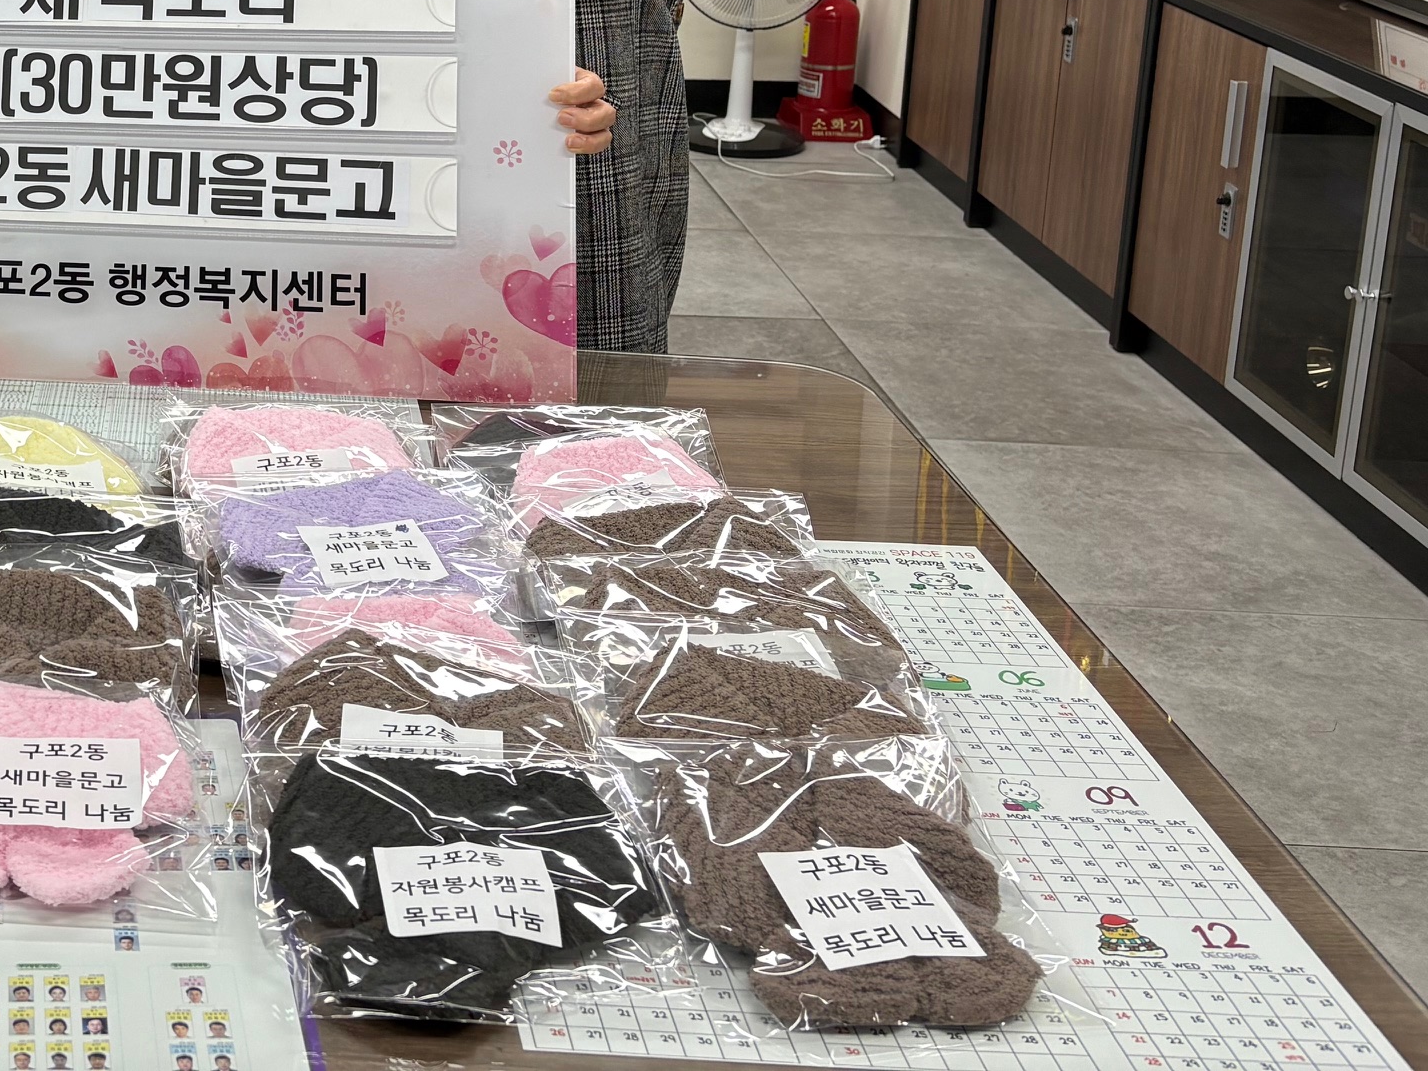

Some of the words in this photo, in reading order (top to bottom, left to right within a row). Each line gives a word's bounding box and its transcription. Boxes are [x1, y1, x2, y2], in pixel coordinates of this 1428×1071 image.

[812, 118, 864, 133] 소화기
[80, 146, 398, 222] 새마을문고
[108, 263, 369, 317] 행정복지센터
[257, 454, 323, 471] 구포2동
[331, 556, 389, 576] 목도리
[397, 553, 433, 572] 나눔
[889, 549, 943, 558] SPACE
[946, 551, 976, 559] 119
[950, 560, 985, 572] 친구들
[729, 641, 782, 655] 포2동
[998, 670, 1045, 686] 06
[379, 723, 459, 744] 구포2동
[19, 741, 109, 763] 구포2동
[0, 763, 128, 790] 새마을문고
[1085, 786, 1139, 807] 09
[84, 801, 136, 824] 나눔
[1091, 808, 1150, 816] SEPTEMBER
[1137, 818, 1157, 826] FRI
[415, 850, 506, 872] 구포2동
[797, 853, 890, 882] 구포2동
[390, 870, 546, 897] 자원봉사캠프
[804, 886, 935, 918] 새마을문고
[401, 903, 478, 929] 목도리
[493, 905, 544, 934] 나눔
[825, 924, 908, 957] 목도리
[917, 921, 969, 952] 나눔
[1192, 922, 1250, 948] 12
[1072, 958, 1095, 966] SUN
[1103, 959, 1130, 967] MON
[1172, 962, 1201, 970] WED
[1212, 963, 1236, 971] THU
[1249, 965, 1272, 973] FRI
[1282, 966, 1305, 974] SAT
[1201, 951, 1261, 960] DECEMBER
